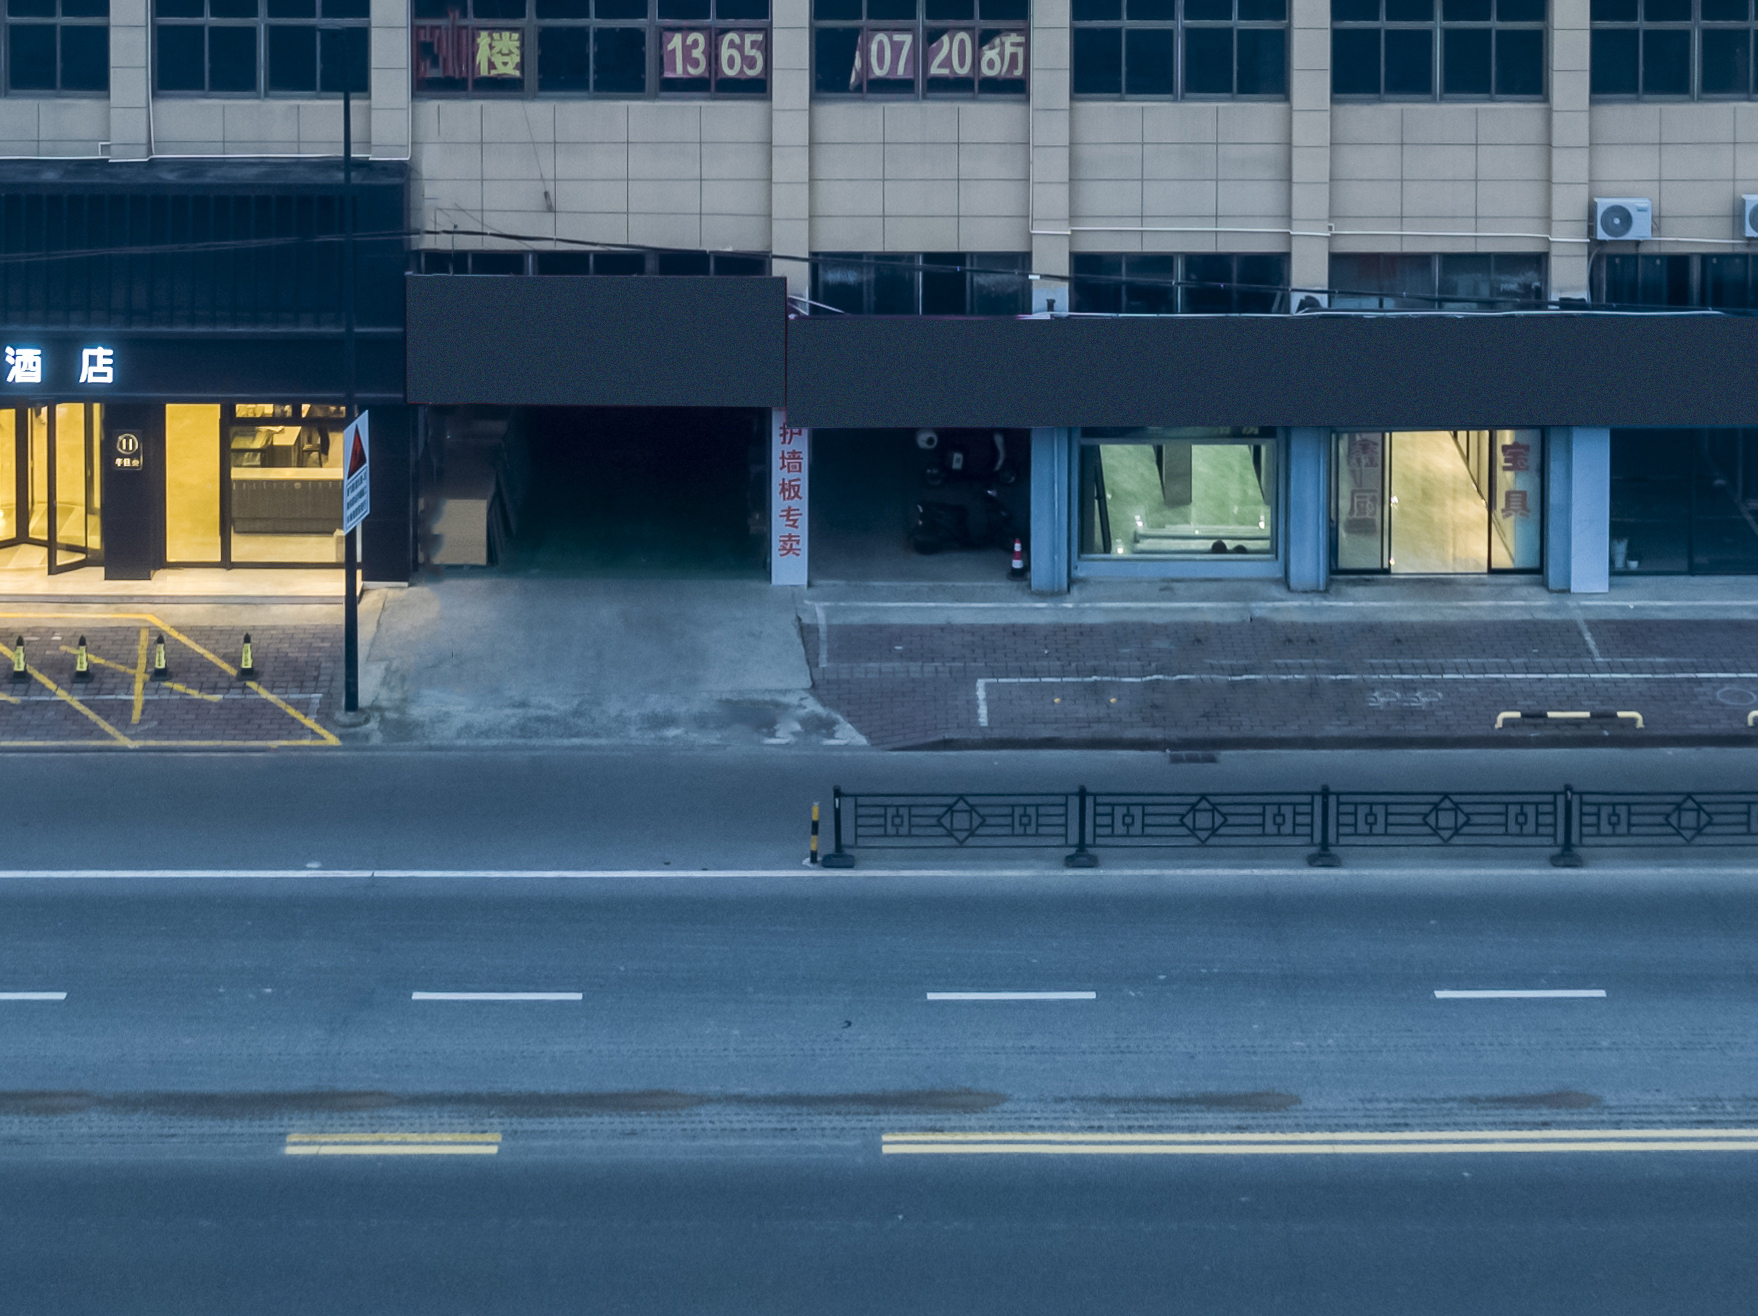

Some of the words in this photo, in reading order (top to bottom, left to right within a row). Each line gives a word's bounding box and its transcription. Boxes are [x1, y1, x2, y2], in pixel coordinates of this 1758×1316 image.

[476, 31, 521, 76] 楼
[778, 421, 804, 557] 护墙板专卖
